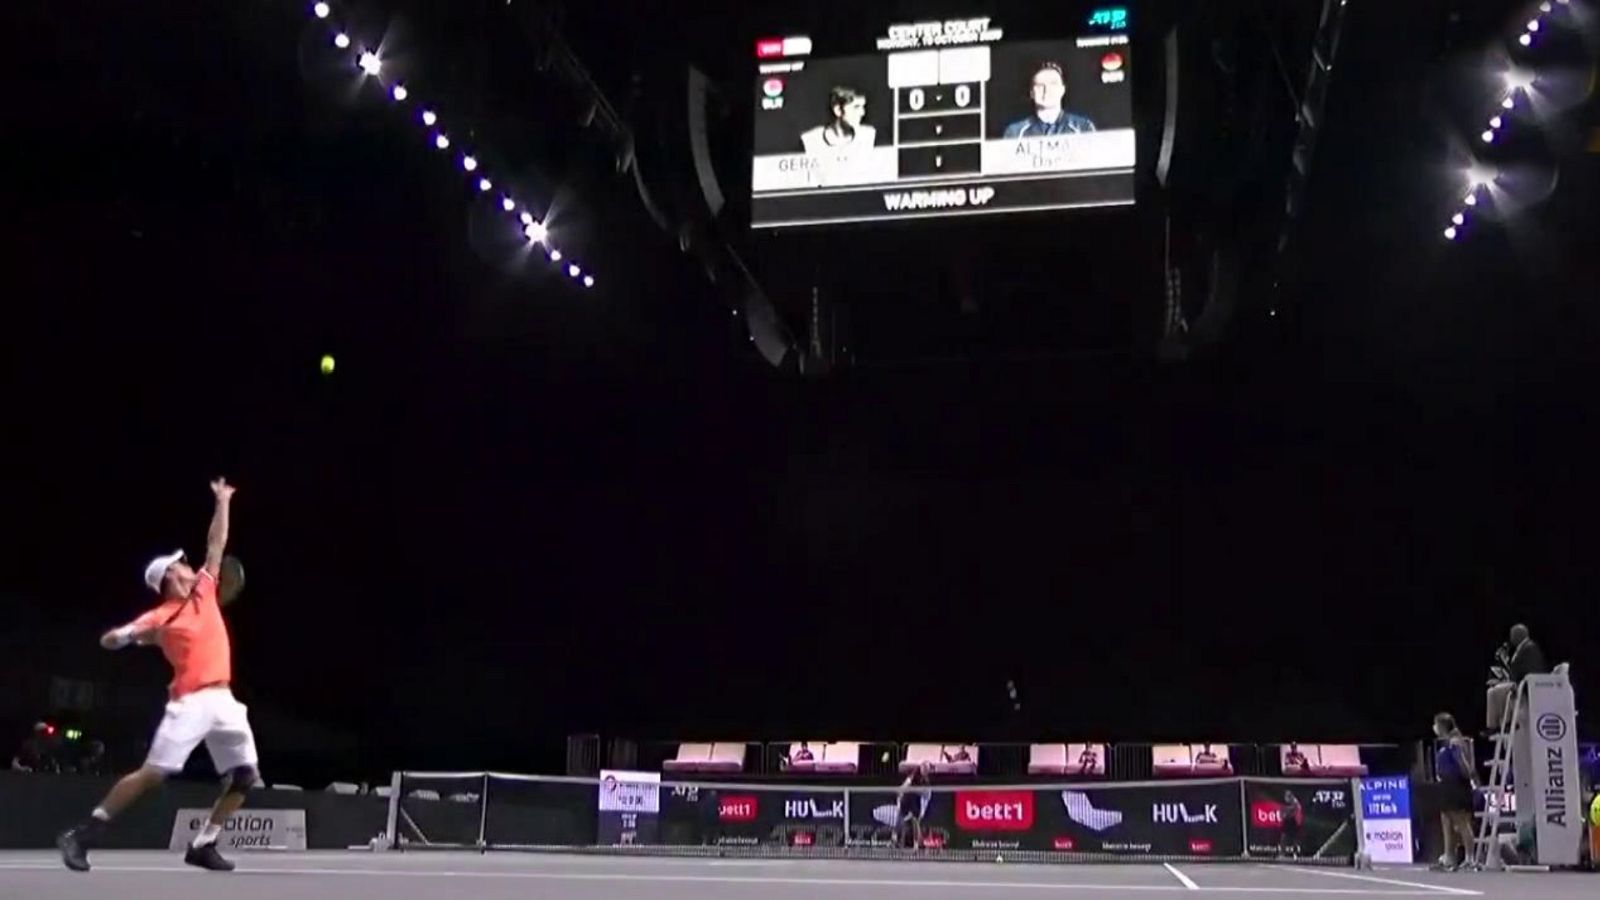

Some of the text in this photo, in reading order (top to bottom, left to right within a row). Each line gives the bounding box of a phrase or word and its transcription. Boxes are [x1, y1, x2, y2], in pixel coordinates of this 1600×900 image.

[889, 22, 942, 41] CENTER
[909, 84, 971, 111] 0 0
[883, 186, 995, 210] WARMING UP
[1545, 746, 1566, 828] Allianz
[966, 801, 1022, 820] bett1
[229, 834, 271, 848] sports
